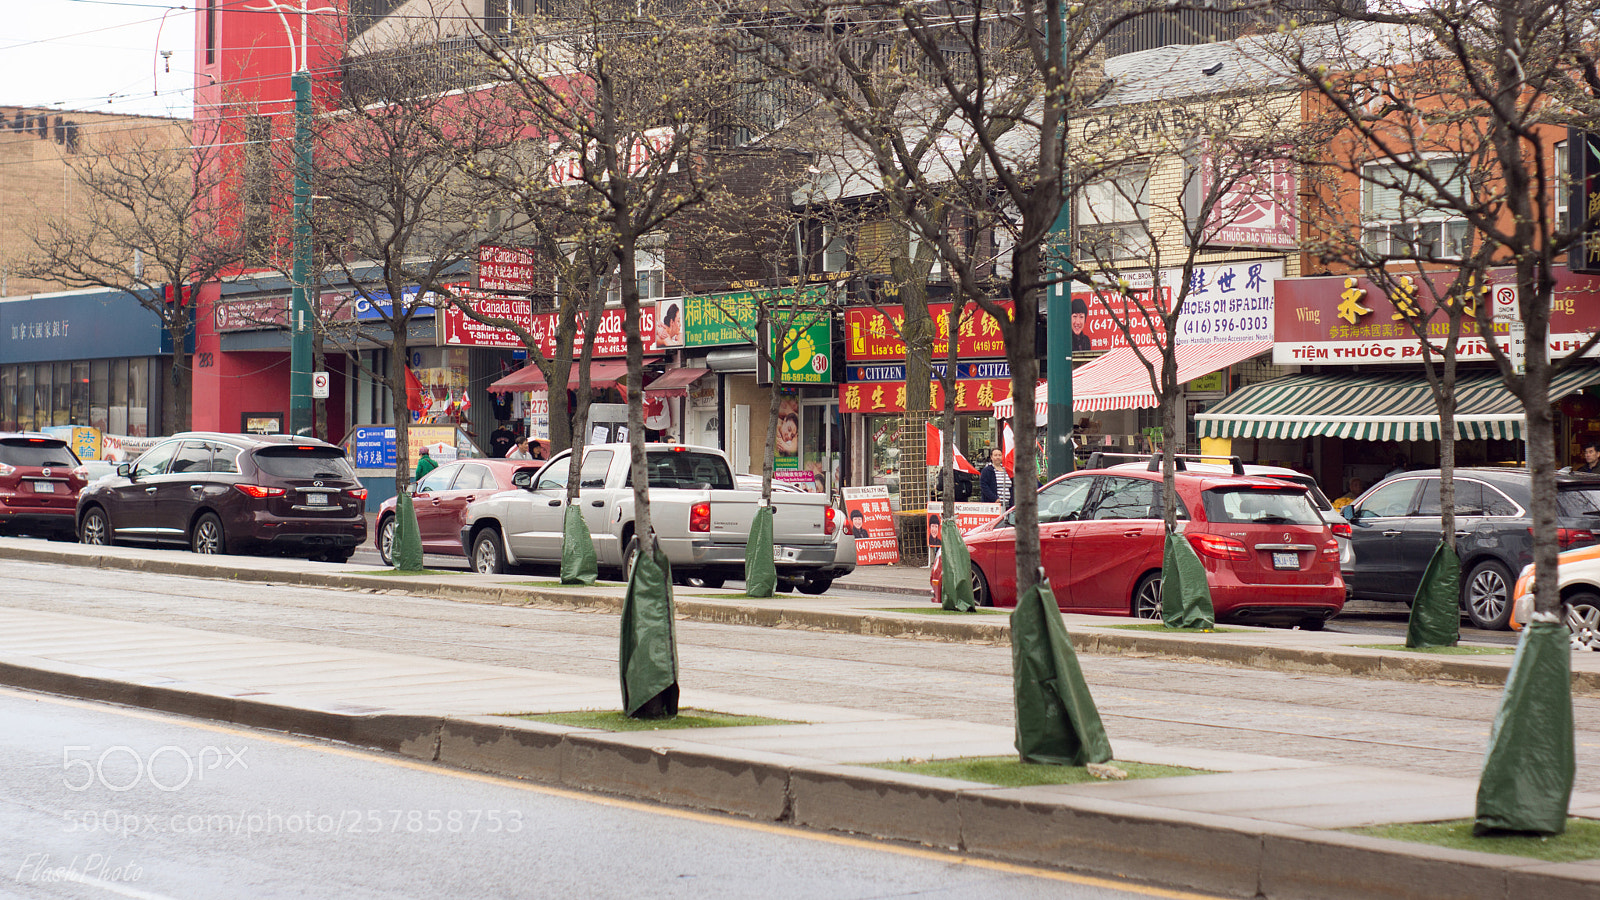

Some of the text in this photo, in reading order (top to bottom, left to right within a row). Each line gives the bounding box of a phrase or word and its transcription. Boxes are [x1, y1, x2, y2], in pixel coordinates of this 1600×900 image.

[1189, 263, 1266, 297] 鞋世界
[480, 300, 510, 313] Canada
[511, 301, 530, 315] Gifts
[1296, 307, 1320, 324] Wing
[1184, 316, 1268, 335] (416) 596-0303
[469, 331, 521, 342] T-Shirts Cap
[686, 330, 702, 344] Tong
[703, 328, 719, 343] Tong
[871, 345, 893, 355] Lisa's
[973, 339, 990, 352] (416)
[199, 352, 213, 368] 283
[812, 355, 827, 371] $30
[865, 366, 902, 380] CITIZEN
[978, 363, 1011, 377] CITIZE
[532, 399, 548, 414] 273
